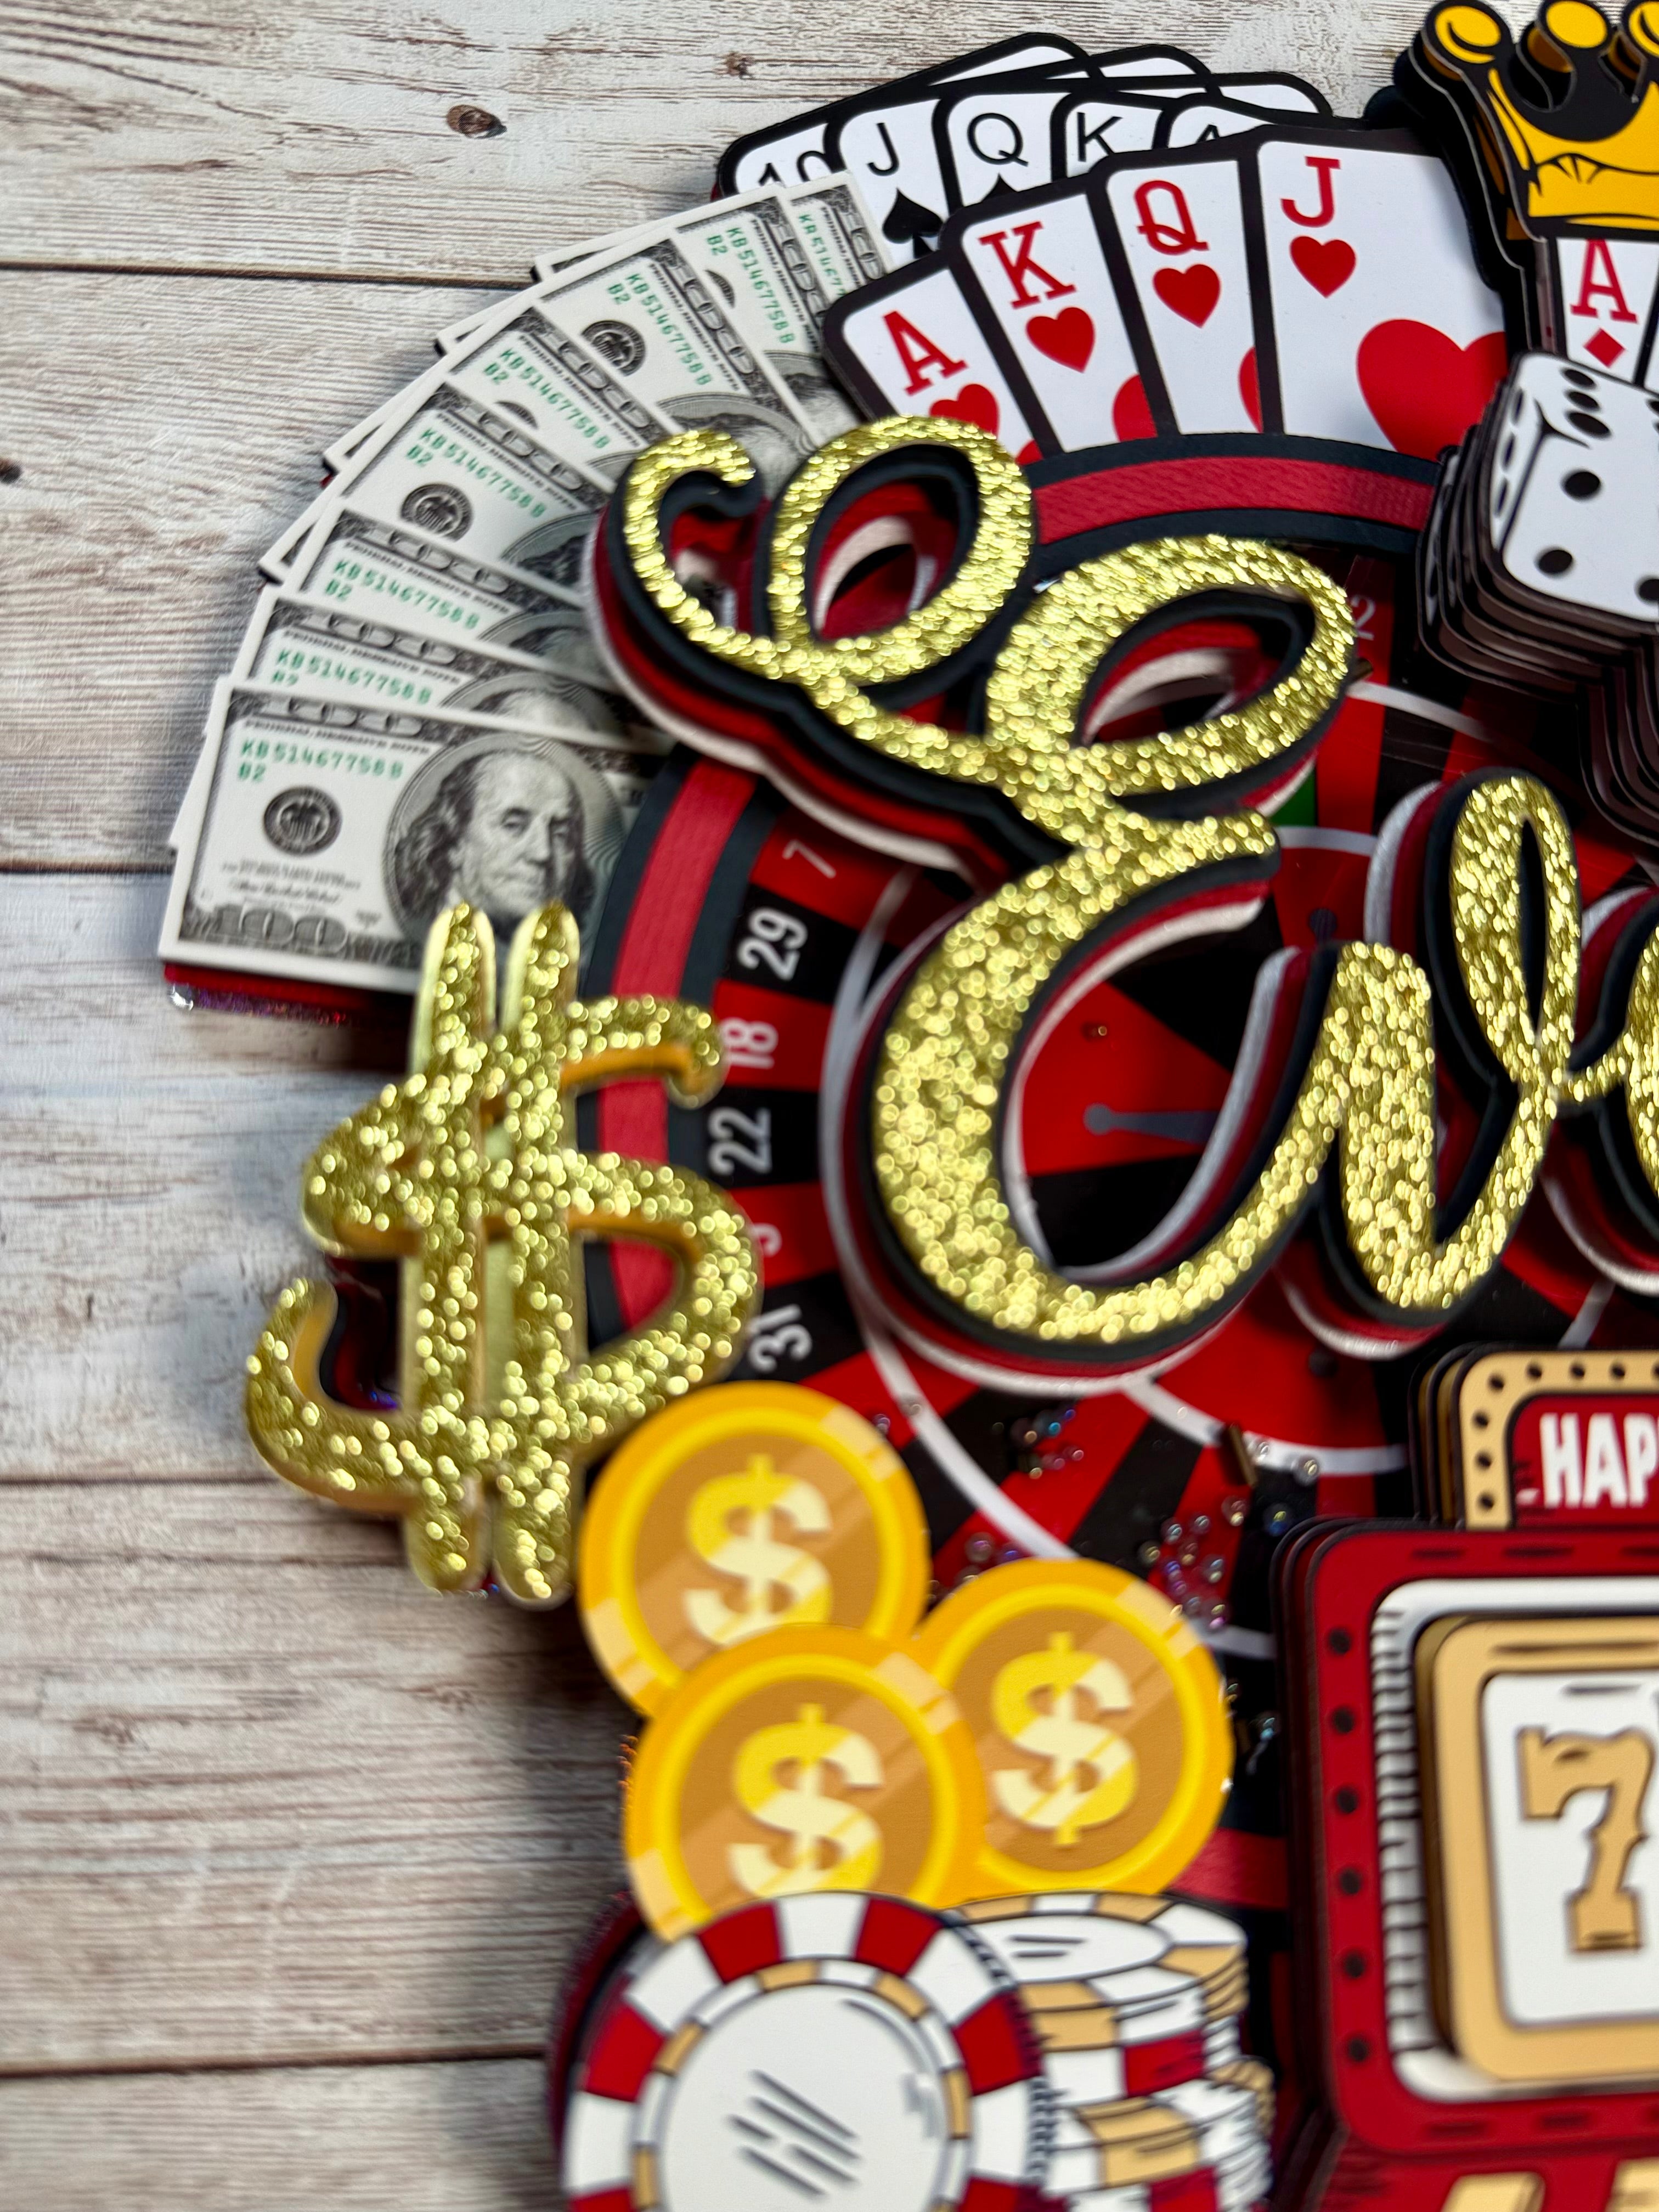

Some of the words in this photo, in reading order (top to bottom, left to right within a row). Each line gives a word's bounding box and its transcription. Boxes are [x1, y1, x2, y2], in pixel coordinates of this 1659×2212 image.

[867, 122, 900, 176] J
[968, 113, 1028, 167] Q
[1077, 112, 1123, 162] K
[1133, 180, 1209, 255] Q
[1280, 156, 1341, 228] J
[978, 221, 1077, 309] K
[1570, 238, 1639, 324] A
[882, 311, 969, 397] A
[781, 838, 837, 879] 7
[737, 906, 809, 981] 29
[708, 1106, 773, 1175] 22
[1539, 1411, 1659, 1509] HAP
[1515, 1725, 1655, 1954] 7
